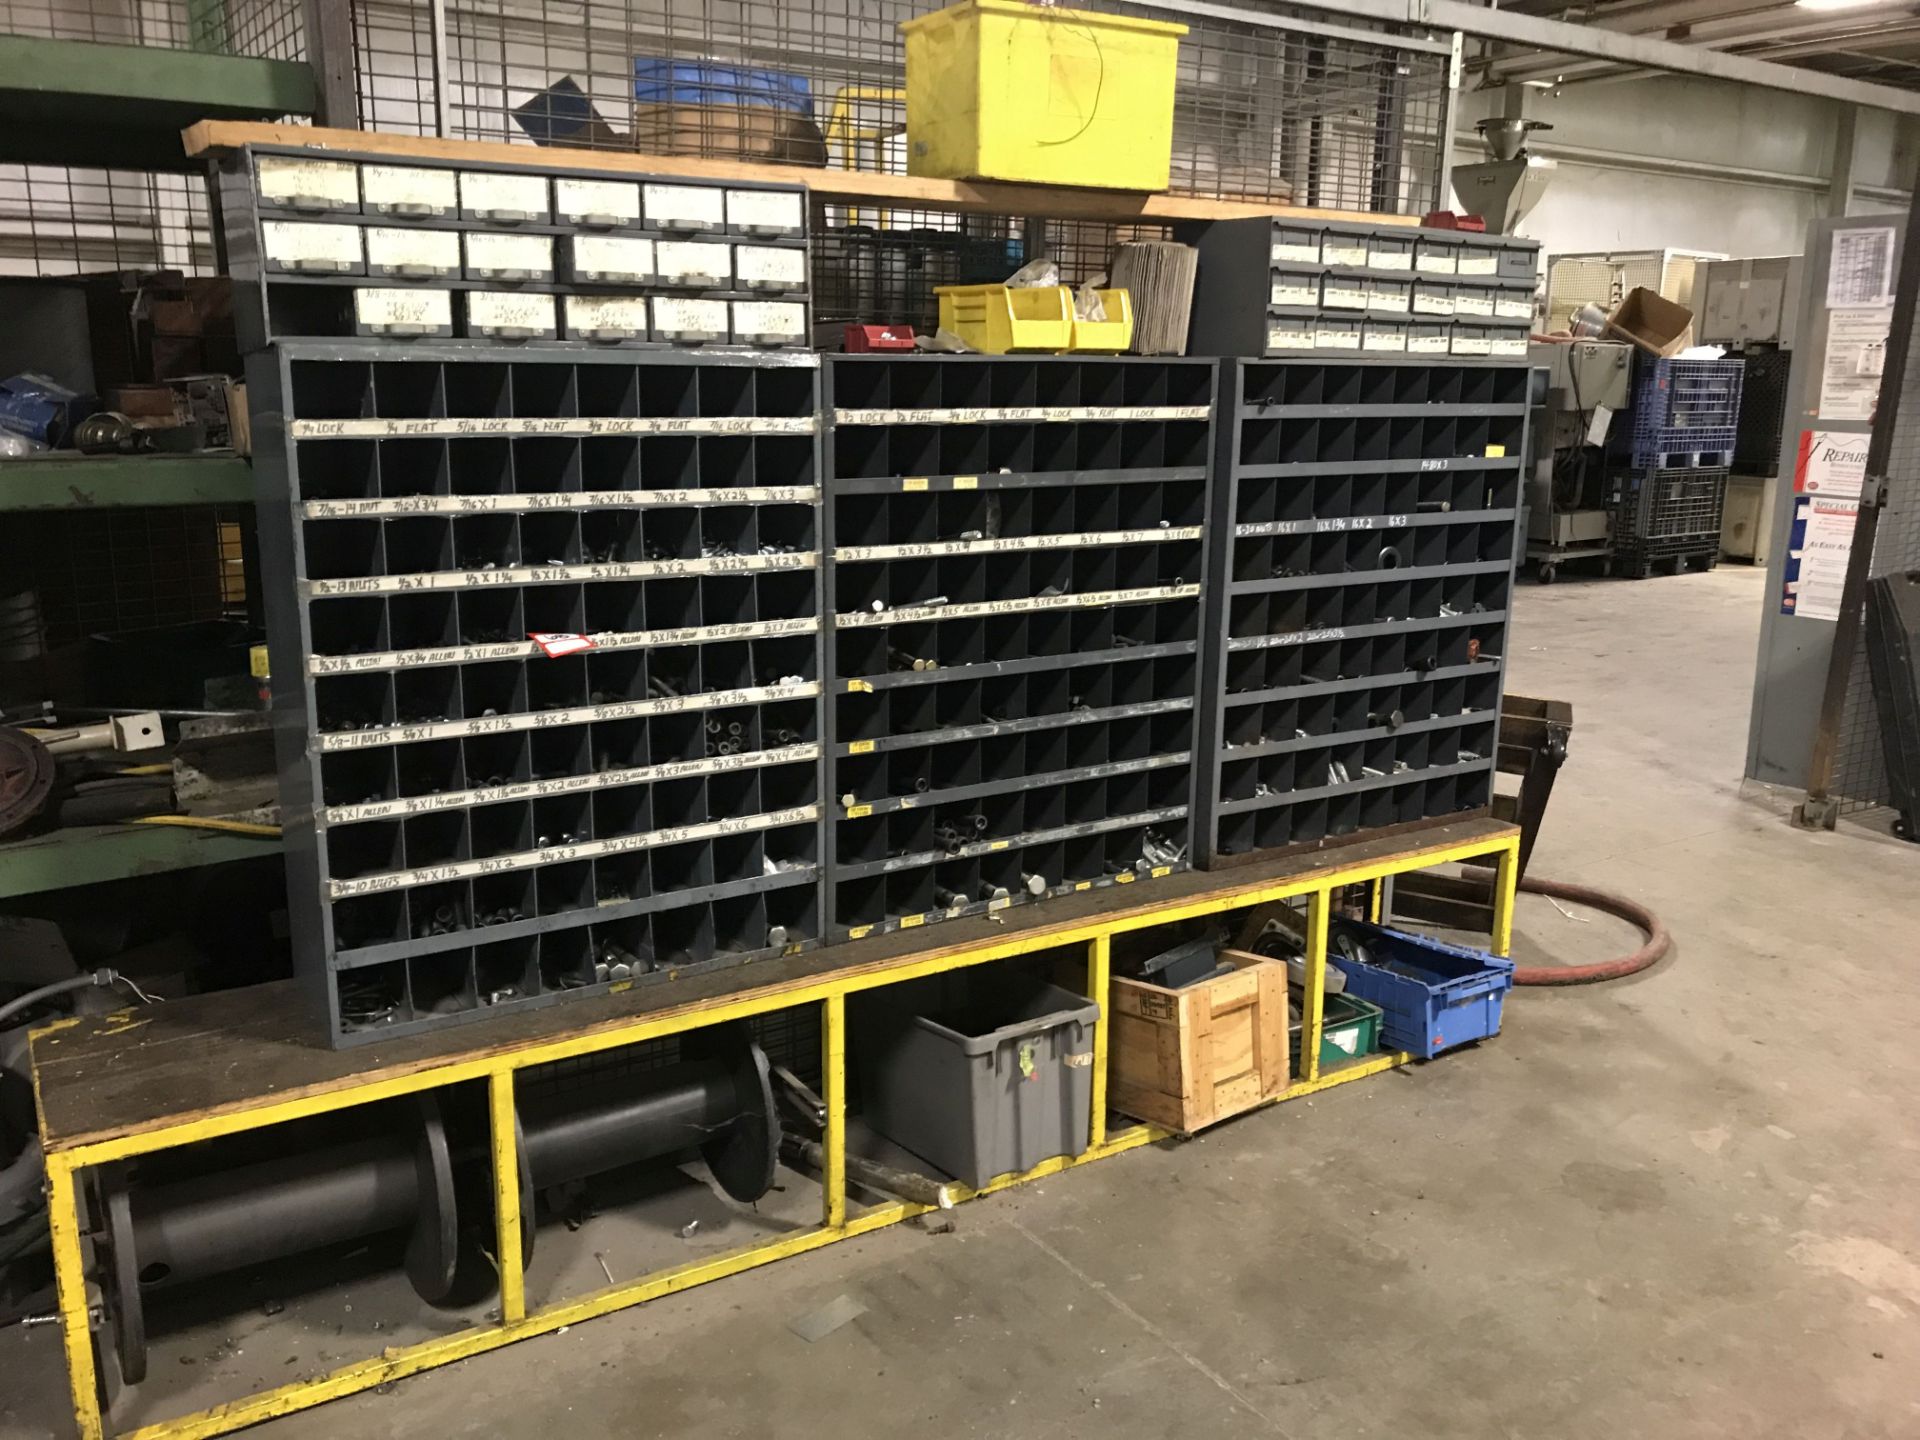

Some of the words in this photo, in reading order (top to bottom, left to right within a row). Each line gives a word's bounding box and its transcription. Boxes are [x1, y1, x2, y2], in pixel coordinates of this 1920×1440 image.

[860, 412, 885, 422] LOCK
[910, 411, 933, 421] FLAT
[317, 423, 344, 434] LOCK
[405, 422, 438, 433] FLAT
[482, 421, 508, 432] LOCK
[543, 421, 568, 432] FLAT
[606, 421, 634, 432] LOCK
[667, 421, 690, 431] FLAT
[727, 421, 752, 431] LOCK
[349, 579, 380, 591] NUTS
[360, 732, 390, 745] NUTS
